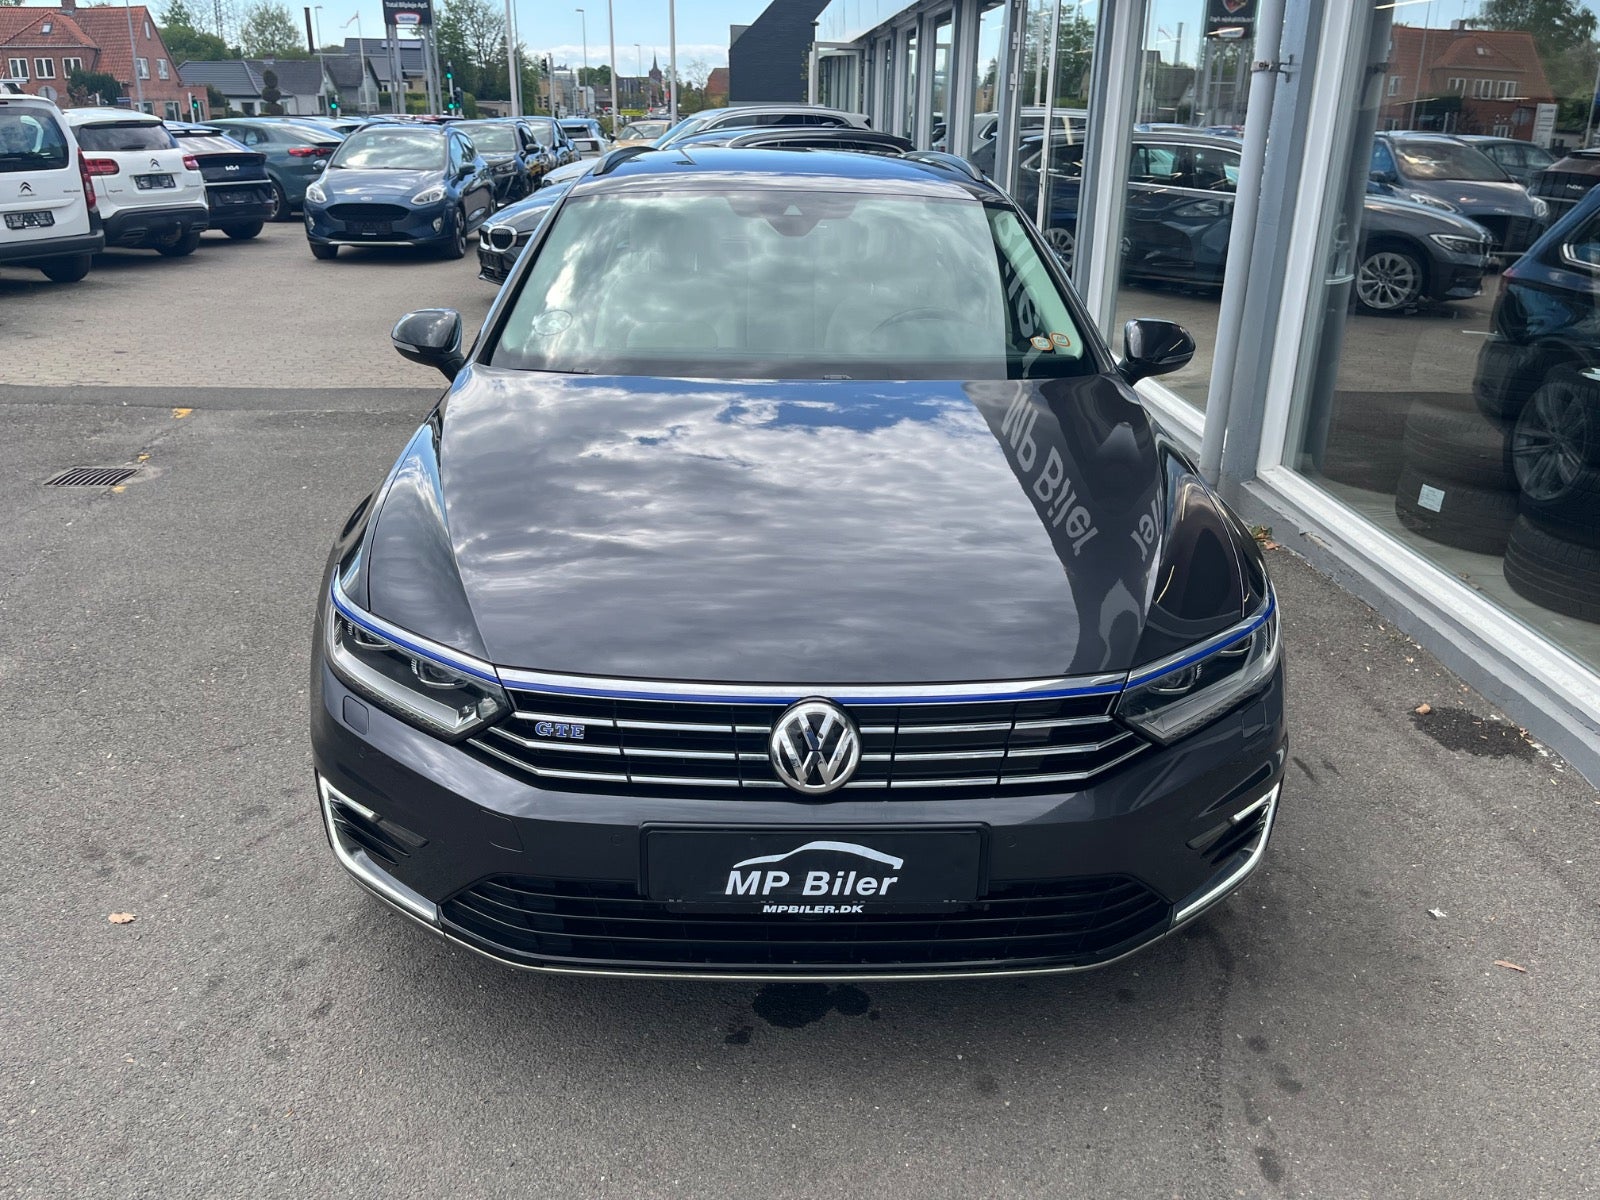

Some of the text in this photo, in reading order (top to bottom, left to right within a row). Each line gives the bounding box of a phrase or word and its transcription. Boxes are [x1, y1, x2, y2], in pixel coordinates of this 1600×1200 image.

[535, 721, 585, 739] GTE
[724, 870, 899, 896] MP Biler
[762, 904, 864, 914] MPBILER.DK
